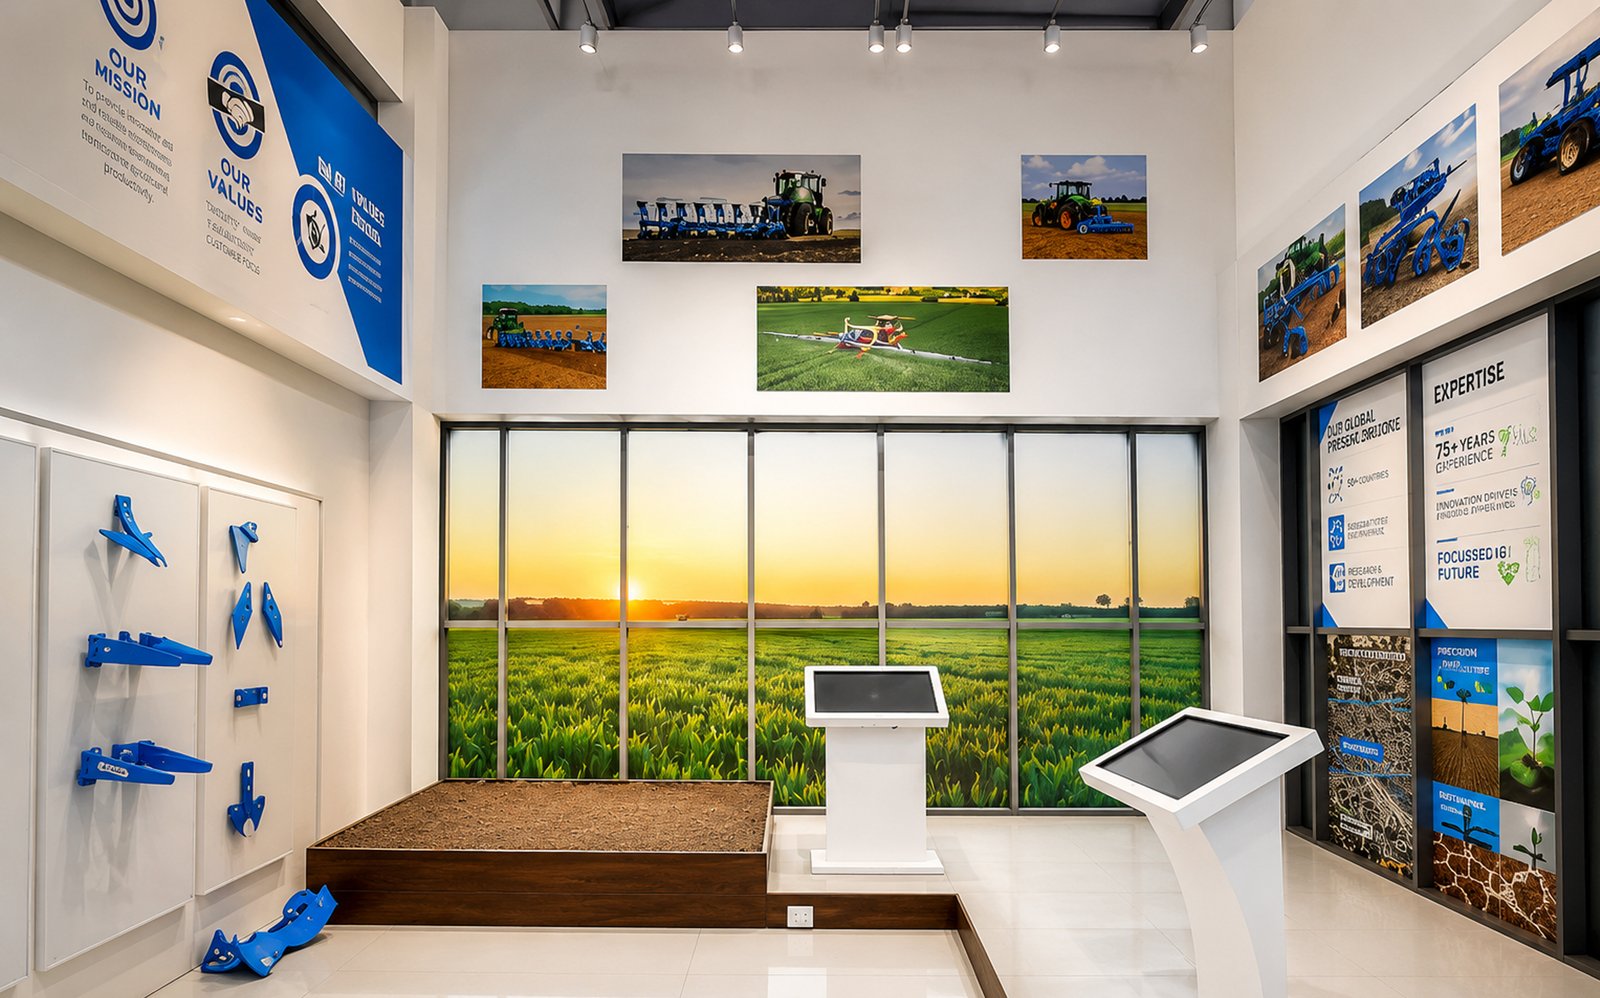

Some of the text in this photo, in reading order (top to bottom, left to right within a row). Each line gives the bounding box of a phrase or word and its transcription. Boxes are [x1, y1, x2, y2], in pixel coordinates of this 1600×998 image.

[109, 48, 146, 90] OUR
[95, 58, 160, 120] MISSION
[221, 157, 250, 194] OUR
[207, 169, 262, 223] VALUES
[1434, 361, 1505, 405] EXPERTISE
[1344, 409, 1376, 432] GLOBAL
[1435, 440, 1458, 460] 75+
[1459, 430, 1495, 452] YEARS
[1437, 547, 1493, 565] FOCUSSED
[1438, 565, 1480, 581] FUTURE
